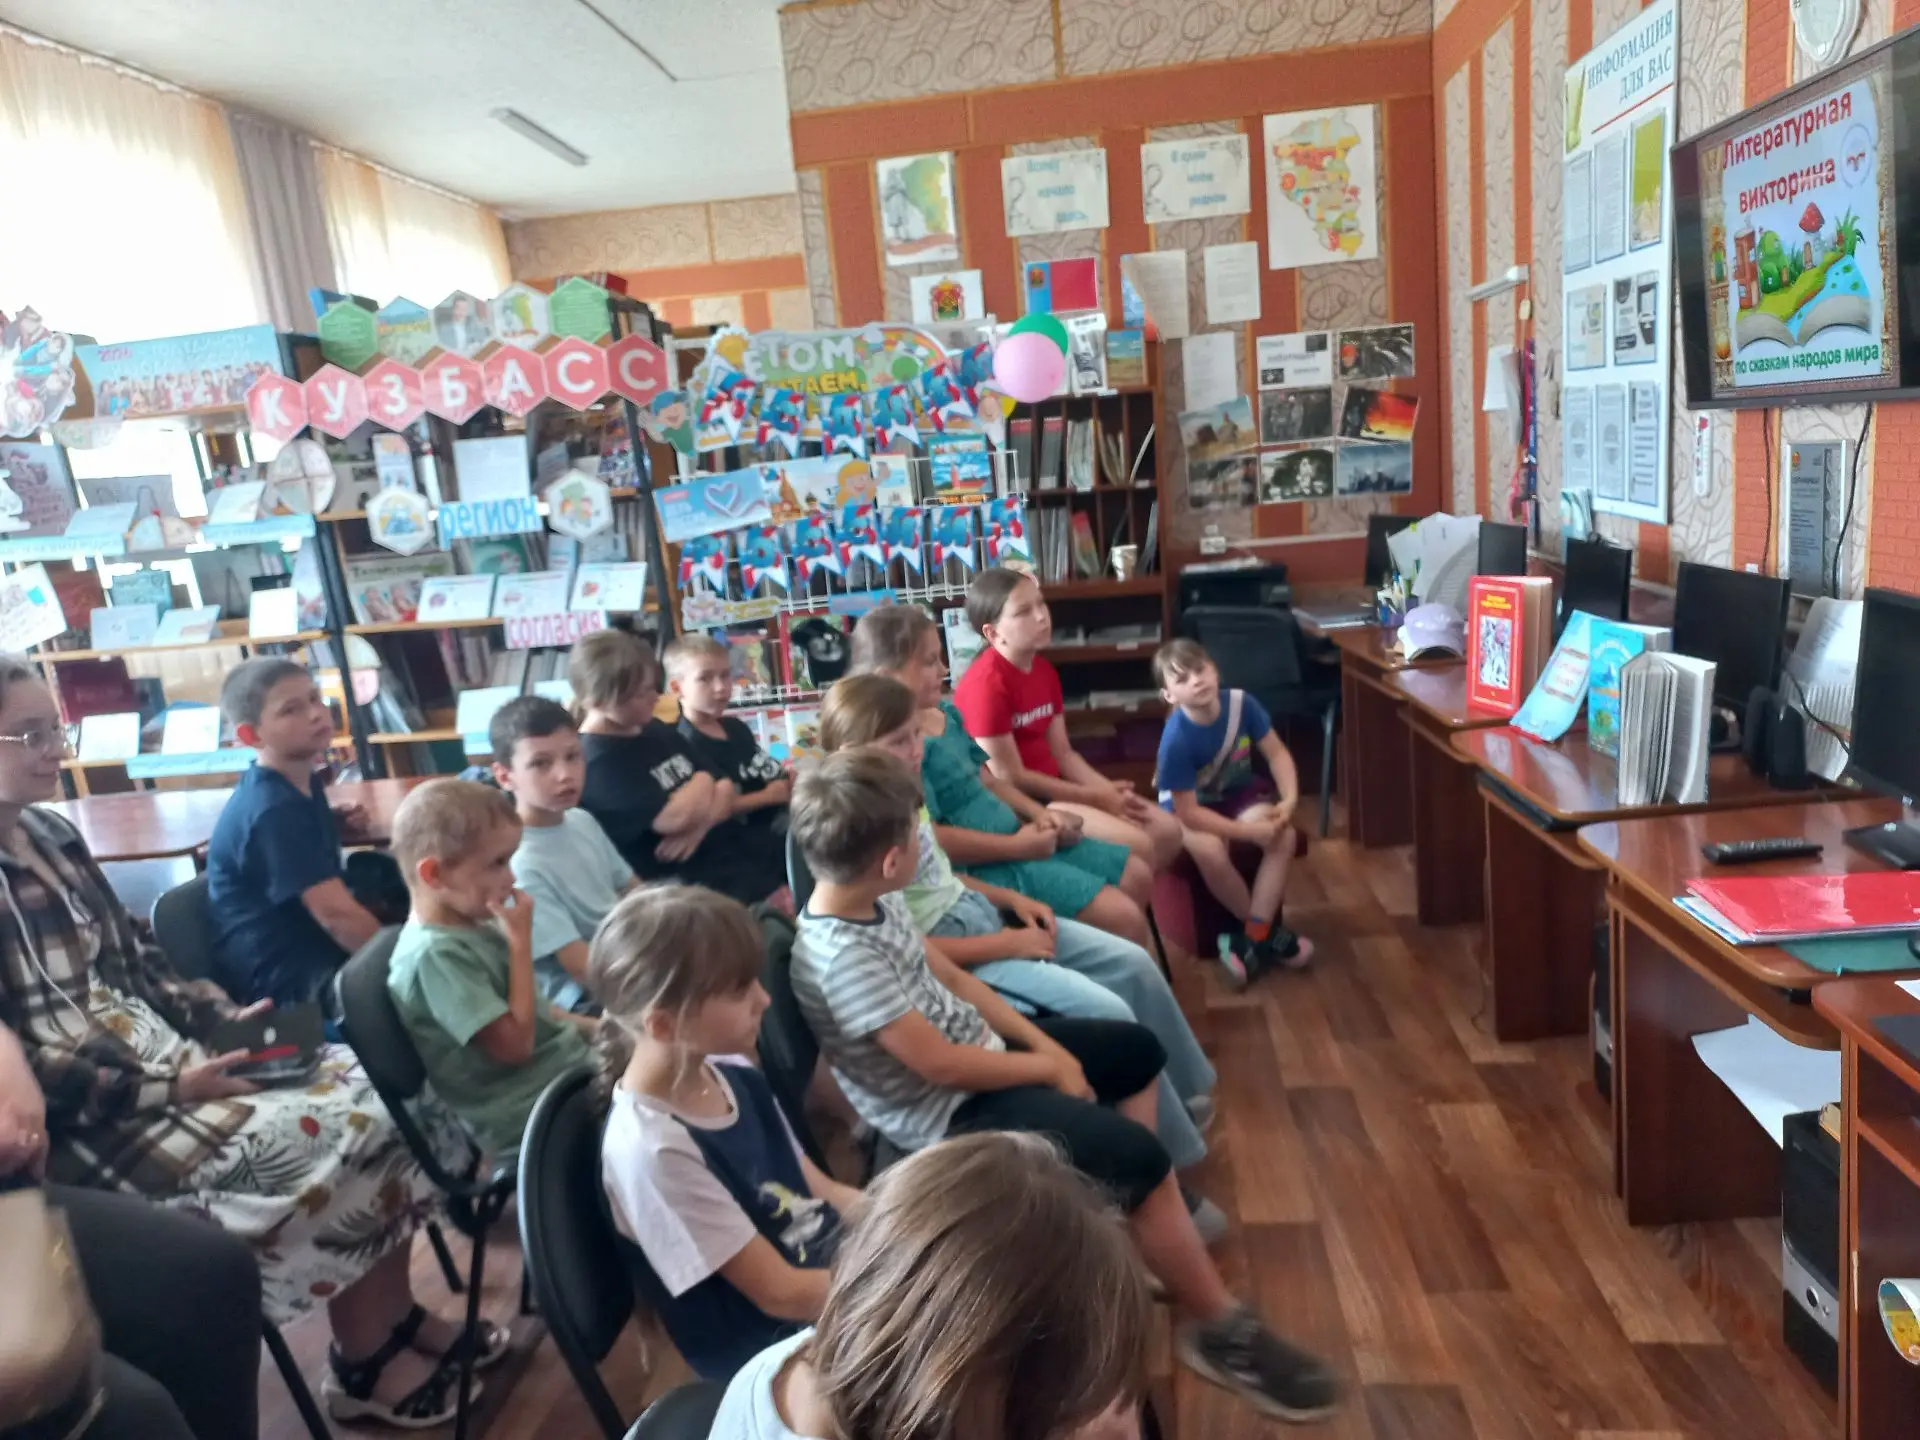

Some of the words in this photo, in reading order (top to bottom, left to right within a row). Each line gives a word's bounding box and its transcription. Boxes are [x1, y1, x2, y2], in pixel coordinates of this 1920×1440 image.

[1588, 8, 1673, 90] ИНФОРМАЦИЯ
[1619, 65, 1645, 104] ДЛЯ
[1649, 45, 1673, 82] ВАС
[1723, 91, 1853, 170] Литературная
[1739, 158, 1836, 215] викторина
[1735, 360, 1747, 374] по
[1748, 354, 1790, 373] сказкам
[1792, 348, 1842, 371] народов
[1844, 344, 1880, 366] мира
[259, 348, 656, 429] КУЗБАСС
[440, 498, 539, 547] регион
[508, 610, 602, 648] согласия
